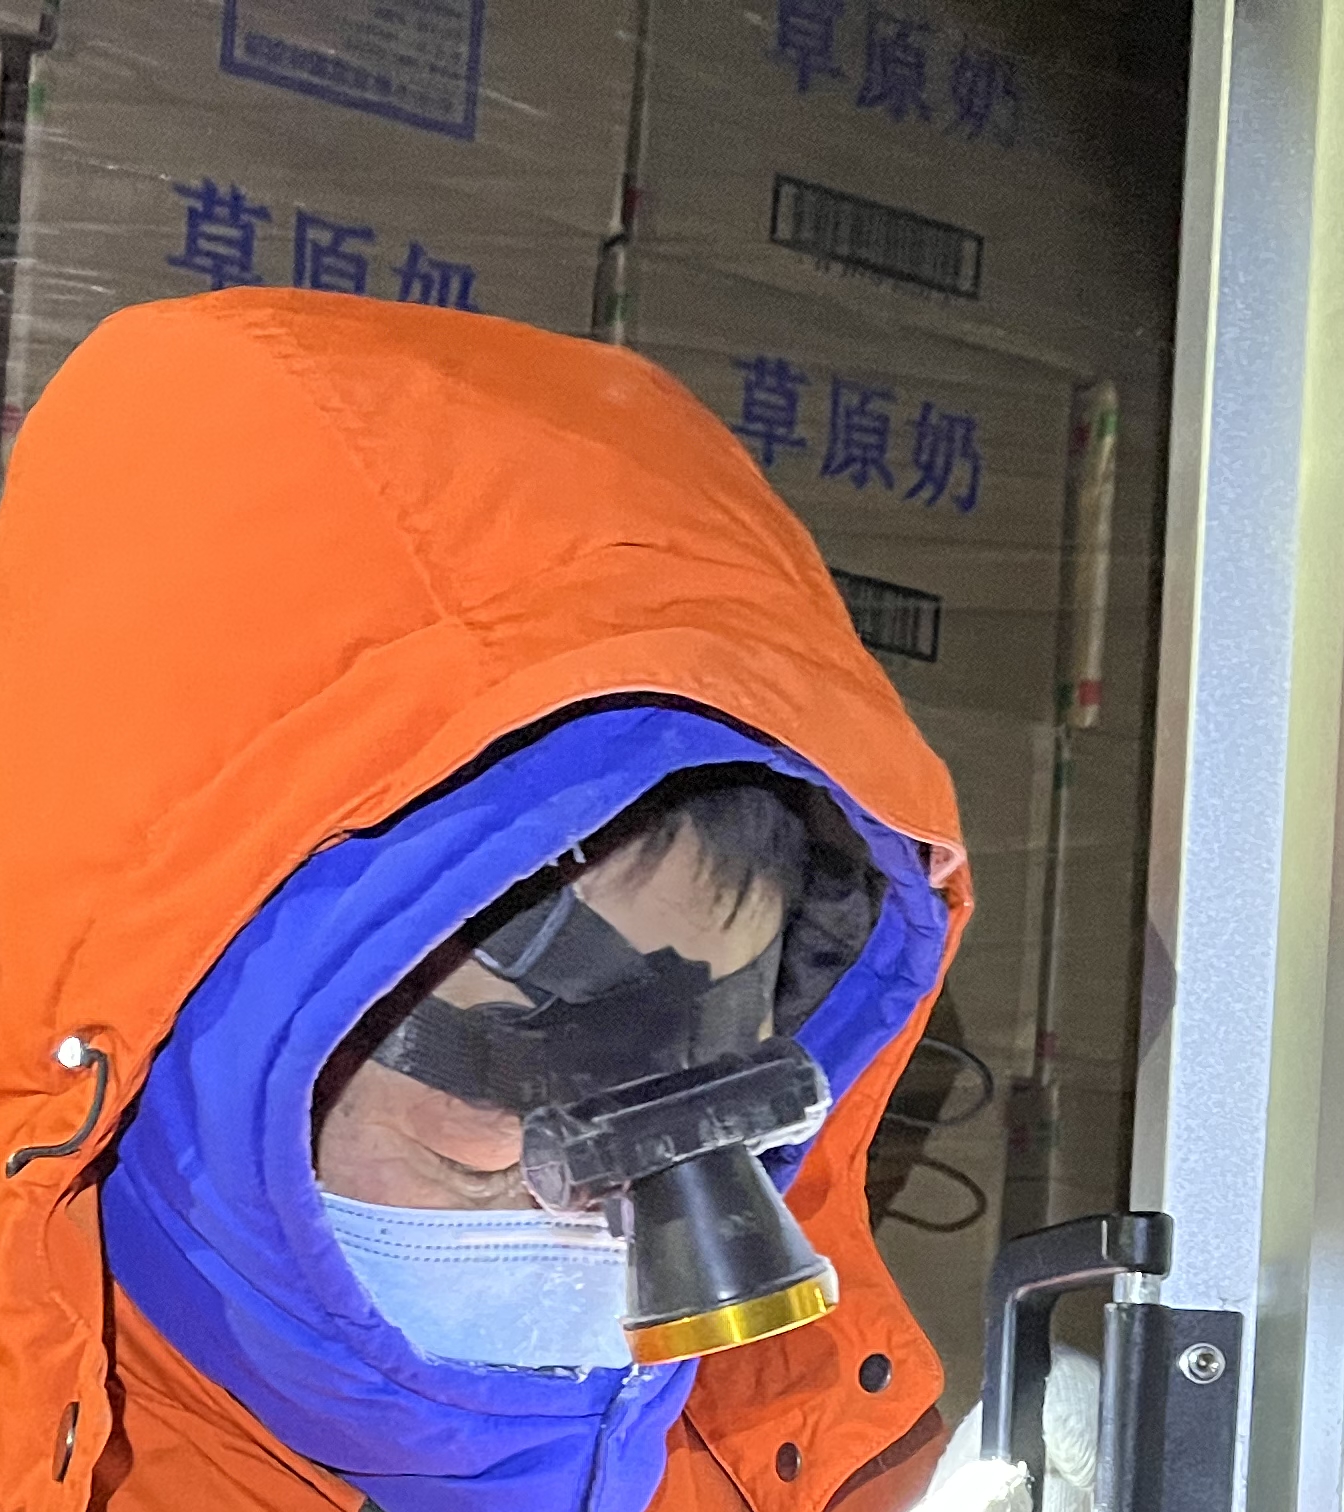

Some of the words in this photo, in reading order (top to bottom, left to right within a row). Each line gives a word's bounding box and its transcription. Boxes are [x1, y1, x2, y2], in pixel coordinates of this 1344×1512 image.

[768, 0, 1026, 148] 草原奶
[730, 355, 981, 514] 草原奶
